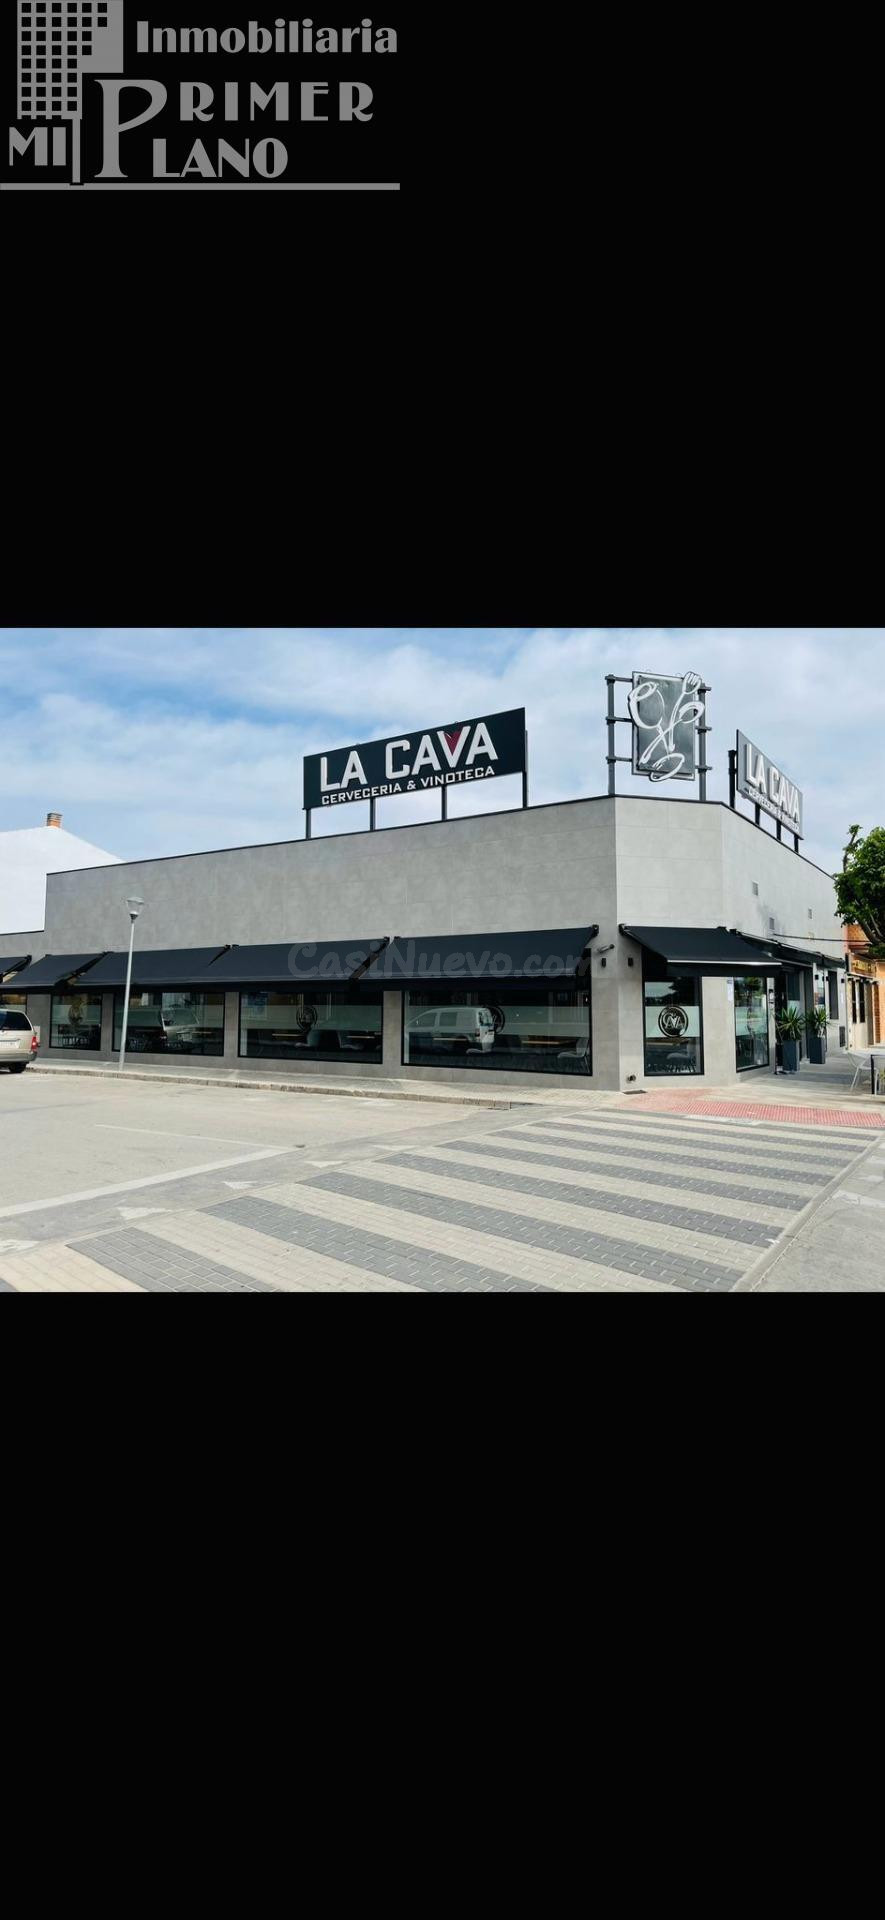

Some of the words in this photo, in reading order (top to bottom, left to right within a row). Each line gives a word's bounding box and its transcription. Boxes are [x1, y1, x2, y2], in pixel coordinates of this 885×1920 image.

[320, 750, 368, 793] LA
[385, 722, 498, 780] CAVA
[321, 783, 402, 805] CERVECERIA
[406, 780, 417, 791] &
[420, 766, 495, 788] VINOTECA
[745, 743, 767, 794] LA
[769, 766, 800, 823] CAVA
